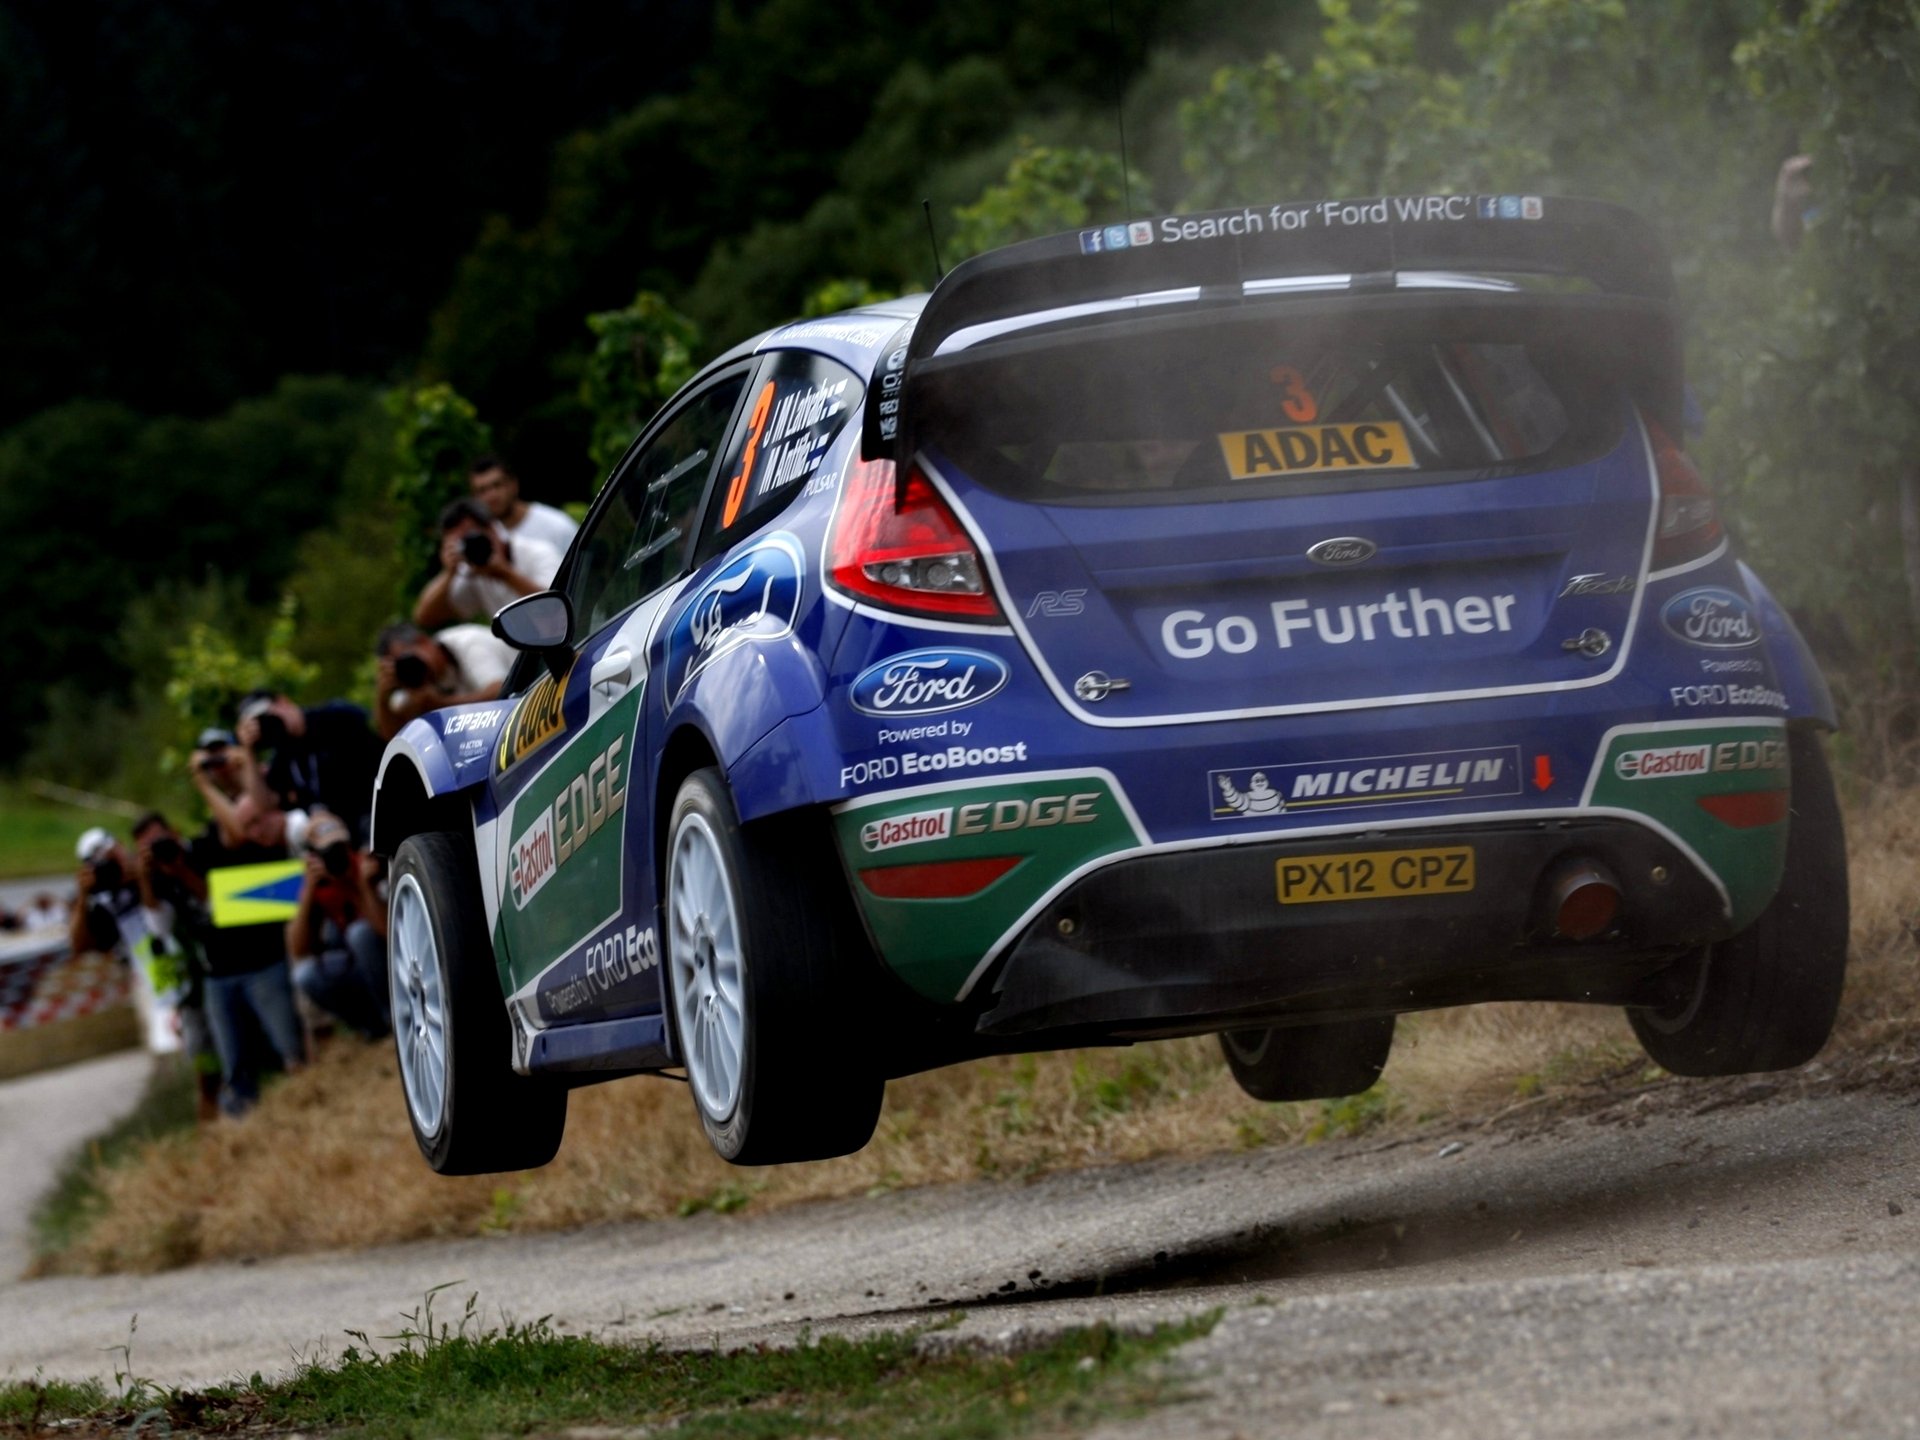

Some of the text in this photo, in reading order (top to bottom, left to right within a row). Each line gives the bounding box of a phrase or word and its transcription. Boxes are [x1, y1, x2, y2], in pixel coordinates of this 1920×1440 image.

[1160, 208, 1263, 243] Search
[1269, 205, 1310, 232] for
[1271, 365, 1318, 423] 3
[722, 380, 776, 529] 3
[1244, 425, 1394, 474] ADAC
[803, 472, 838, 498] PULSAR
[1322, 542, 1363, 561] Ford
[1026, 589, 1088, 618] RS
[1161, 588, 1516, 659] Go Further
[1685, 595, 1753, 638] Ford
[873, 658, 976, 708] Ford
[1670, 684, 1727, 707] FORD
[878, 720, 973, 745] Powered by
[840, 741, 1027, 788] FORD EcoBoost
[1291, 758, 1504, 798] MICHELIN
[1640, 748, 1706, 776] Castrol
[520, 733, 626, 896] Castrol EDGE
[880, 792, 1103, 846] Castrol EDGE
[1282, 854, 1469, 898] PX12 CPZ
[586, 932, 628, 995] FORD
